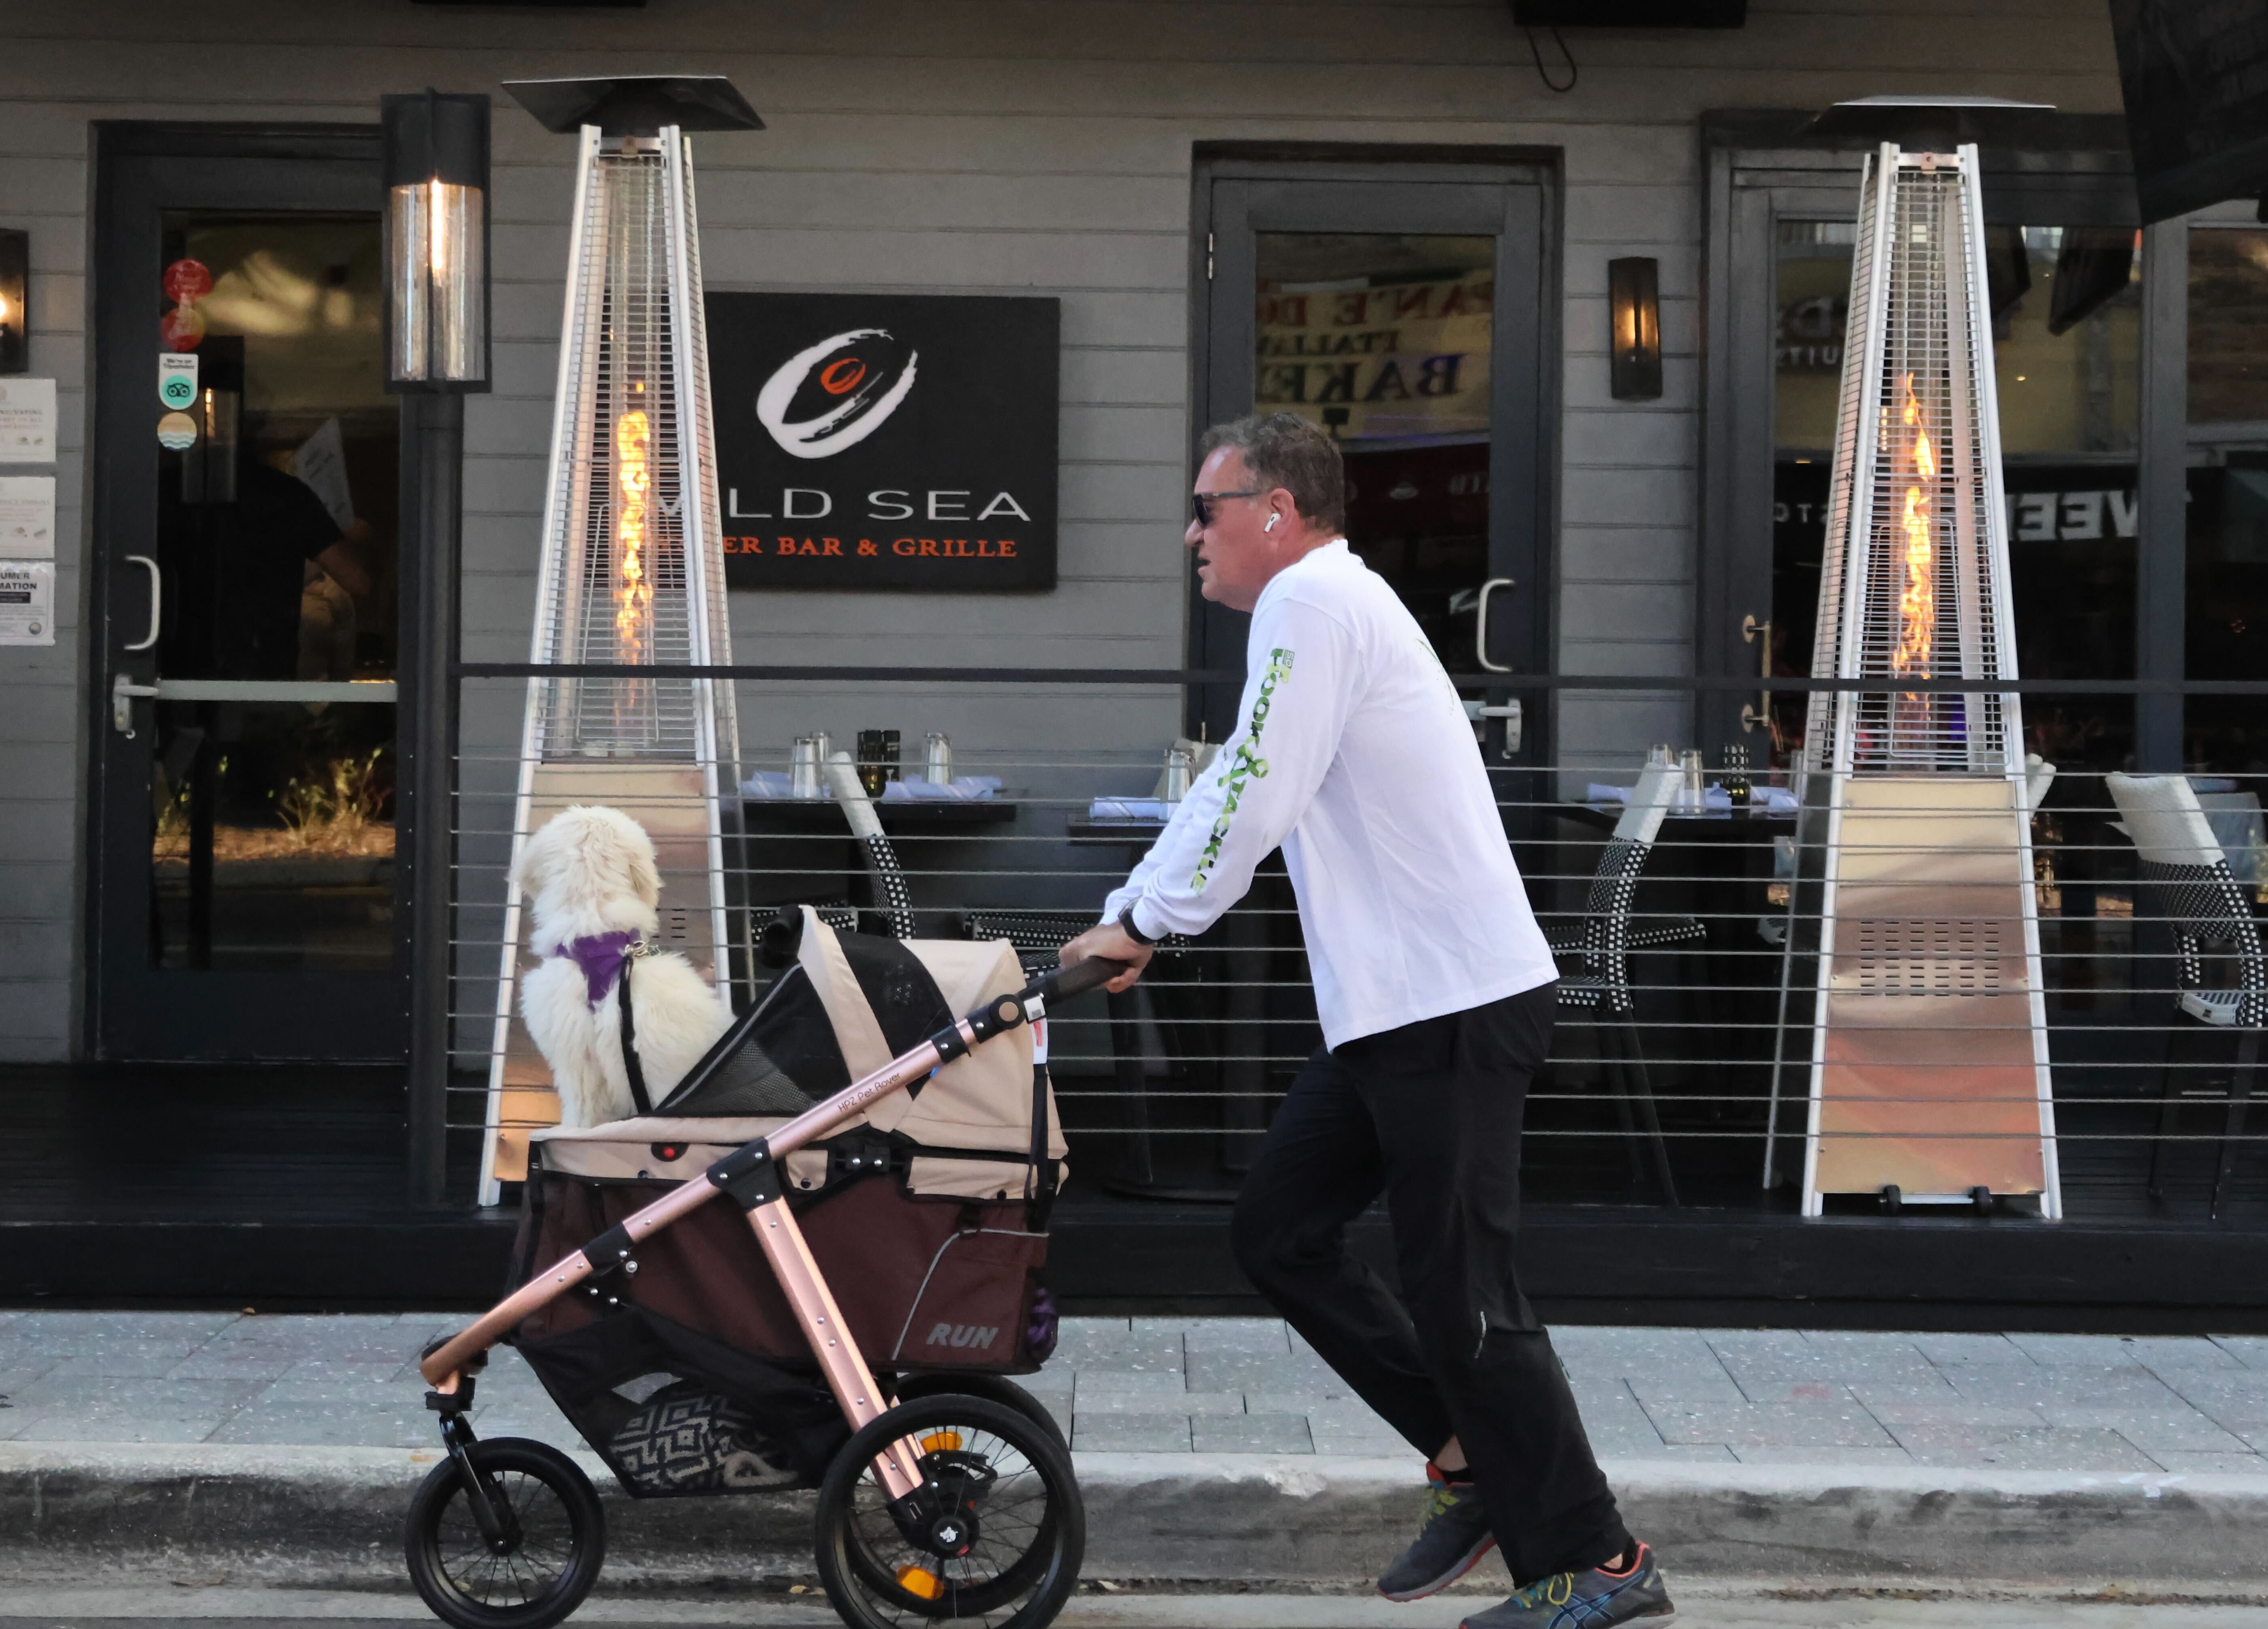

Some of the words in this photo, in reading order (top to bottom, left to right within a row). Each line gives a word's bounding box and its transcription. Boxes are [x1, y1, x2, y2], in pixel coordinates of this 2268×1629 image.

[729, 488, 832, 518] LD
[867, 490, 1031, 522] SEA
[777, 537, 844, 556] BAR
[857, 539, 878, 556] &
[892, 538, 1017, 557] GRILLE
[1246, 648, 1284, 749] HOOK
[838, 1096, 857, 1112] HPZ
[857, 1088, 874, 1101] Pet
[874, 1073, 901, 1091] Rover
[926, 1322, 999, 1349] RUN
